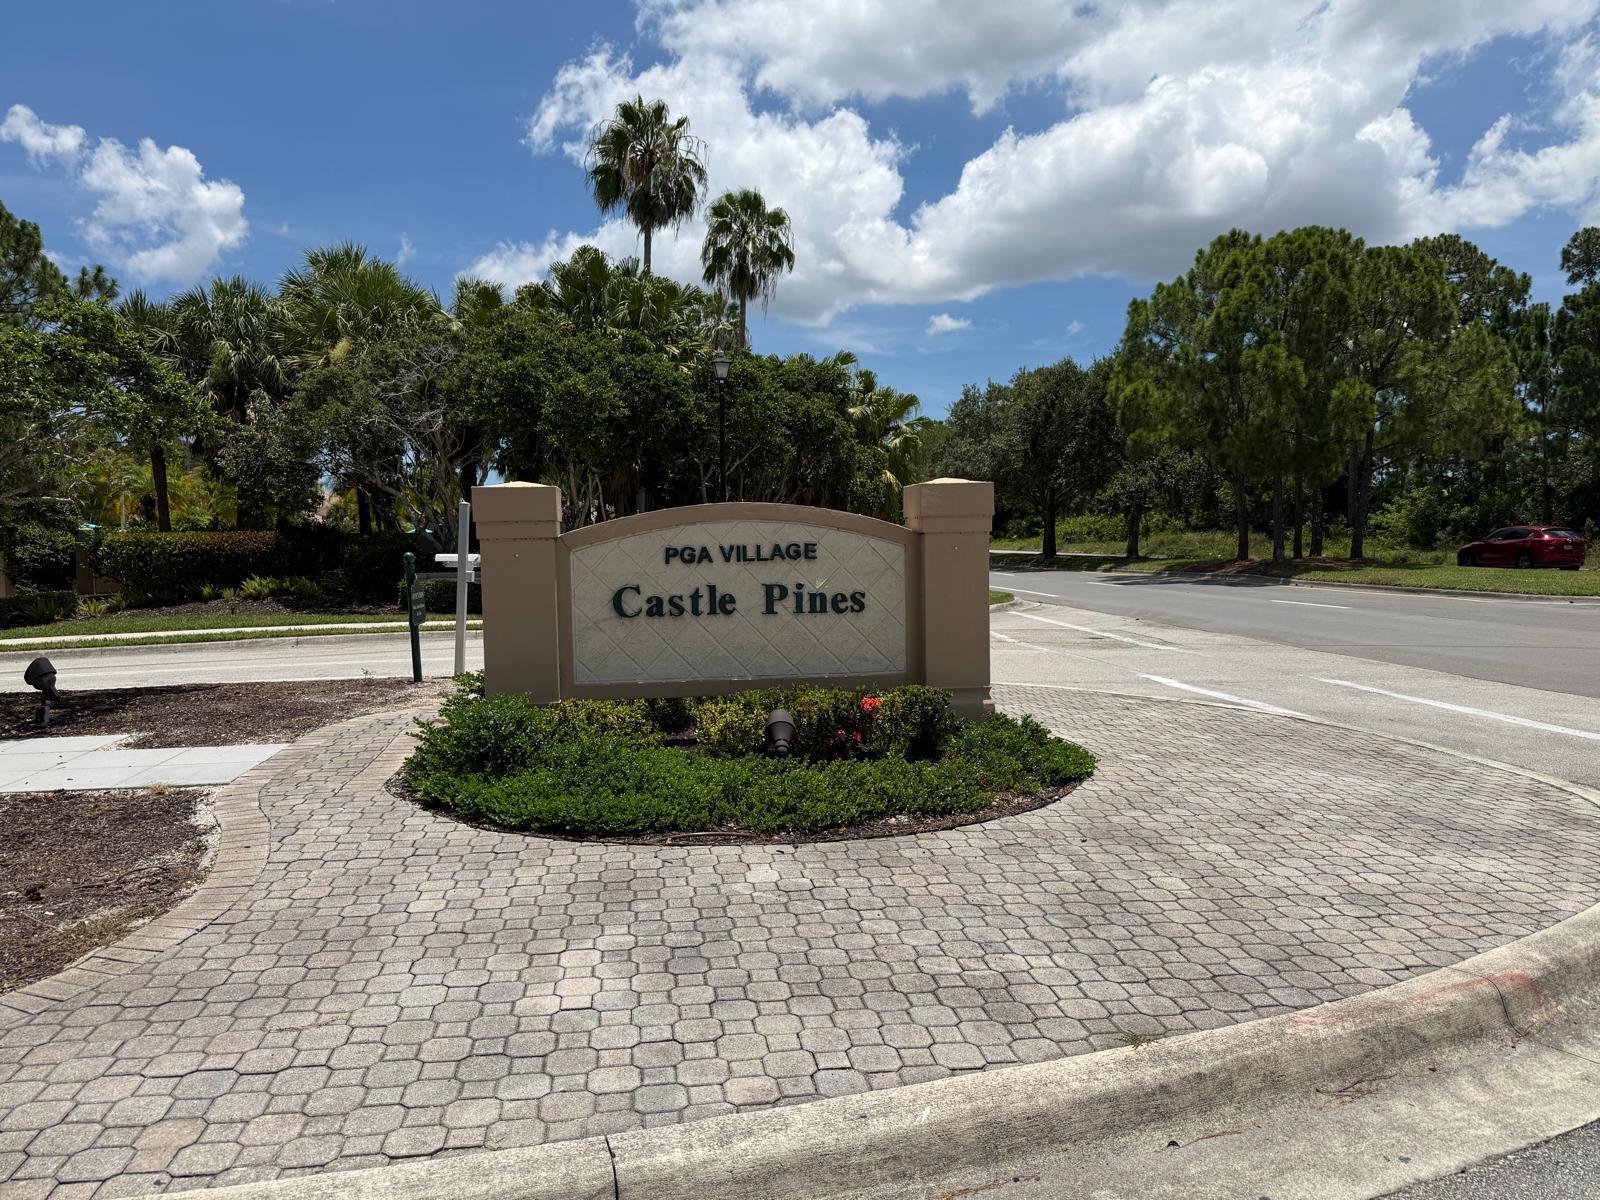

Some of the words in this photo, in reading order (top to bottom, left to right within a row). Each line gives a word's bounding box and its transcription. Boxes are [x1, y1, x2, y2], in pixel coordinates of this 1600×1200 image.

[665, 545, 713, 564] PGA
[719, 543, 818, 563] VILLAGE
[612, 583, 736, 618] Castle
[762, 583, 866, 615] Pines
